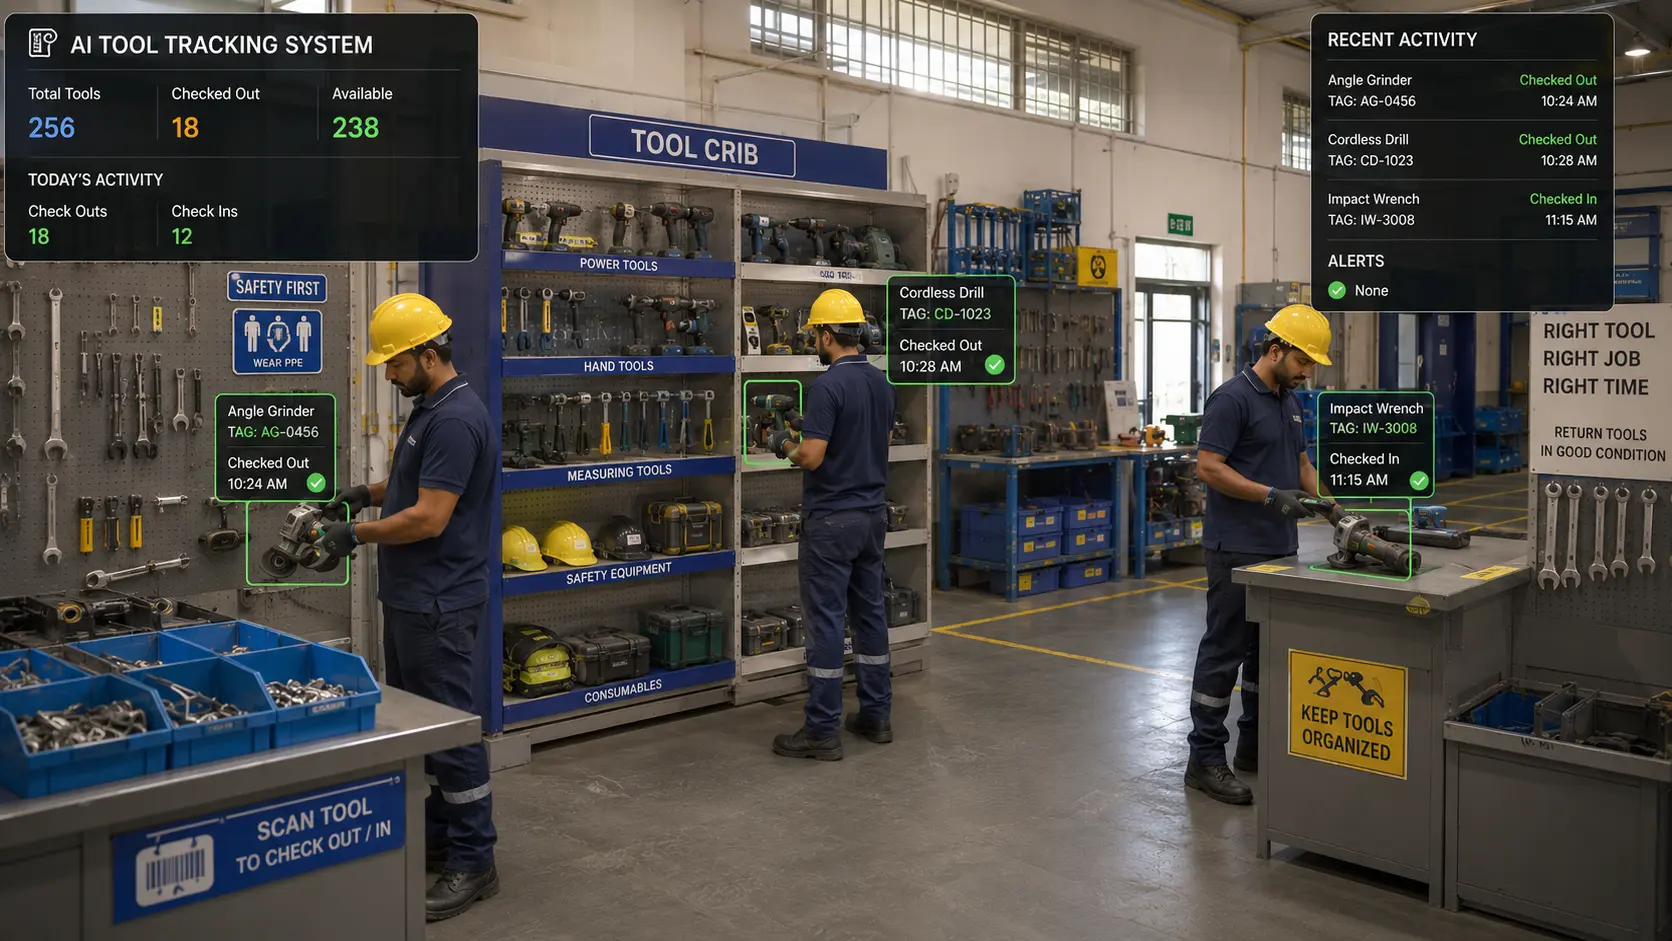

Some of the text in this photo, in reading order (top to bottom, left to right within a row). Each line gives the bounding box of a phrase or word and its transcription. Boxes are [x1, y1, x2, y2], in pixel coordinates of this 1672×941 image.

[630, 128, 759, 165] TOOL CRIB
[581, 258, 657, 271] POWER TOOLS
[236, 279, 319, 295] SAFETY FIRST
[1545, 322, 1655, 338] RIGHT TOOL
[253, 358, 302, 367] WEAR PPE
[585, 361, 653, 371] HAND TOOLS
[1544, 351, 1640, 366] RIGHT JOB
[1544, 378, 1648, 395] RIGHT TIME
[1555, 426, 1647, 441] RETURN TOOLS
[1541, 445, 1665, 461] IN GOOD CONDITION
[567, 464, 671, 482] MEASURING TOOLS
[566, 562, 672, 585] SAFETY EQUIPMENT
[585, 679, 662, 704] CONSUMABLES
[1302, 704, 1393, 737] KEEP TOOLS
[1302, 728, 1391, 761] ORGANIZED
[257, 797, 373, 841] SCAN TOOL
[236, 820, 391, 873] TO CHECK OUT / IN
